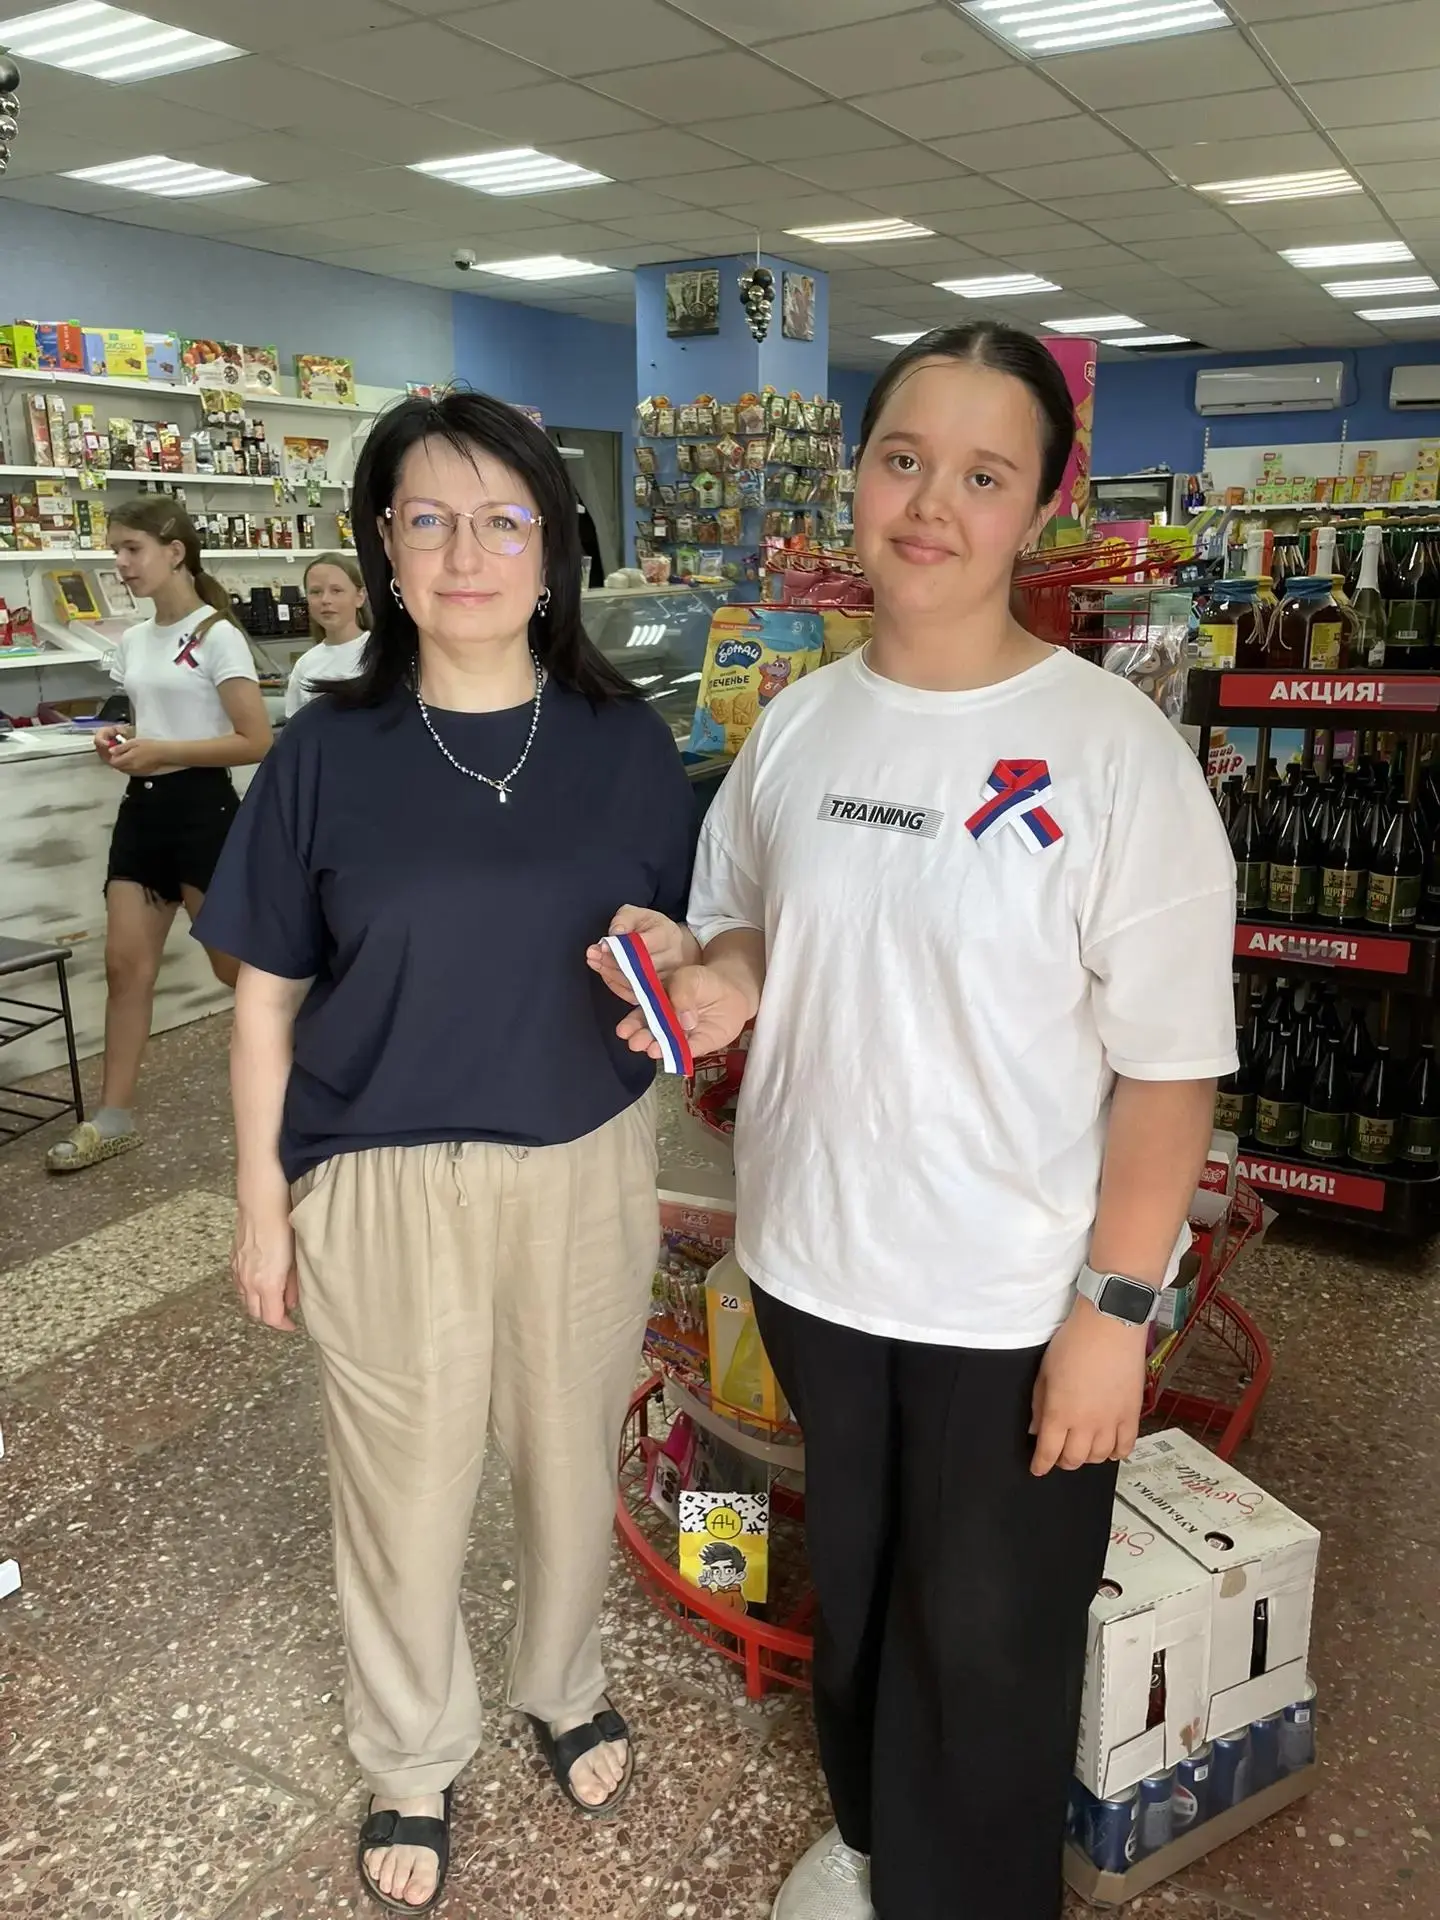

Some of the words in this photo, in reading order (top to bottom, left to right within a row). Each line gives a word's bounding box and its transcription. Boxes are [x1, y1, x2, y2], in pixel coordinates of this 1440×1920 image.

[1270, 681, 1384, 704] АКЦИЯ!
[829, 799, 926, 830] TRAINING
[1248, 932, 1357, 960] АКЦИЯ!
[1235, 1161, 1336, 1195] АКЦИЯ!
[711, 1513, 736, 1531] A4
